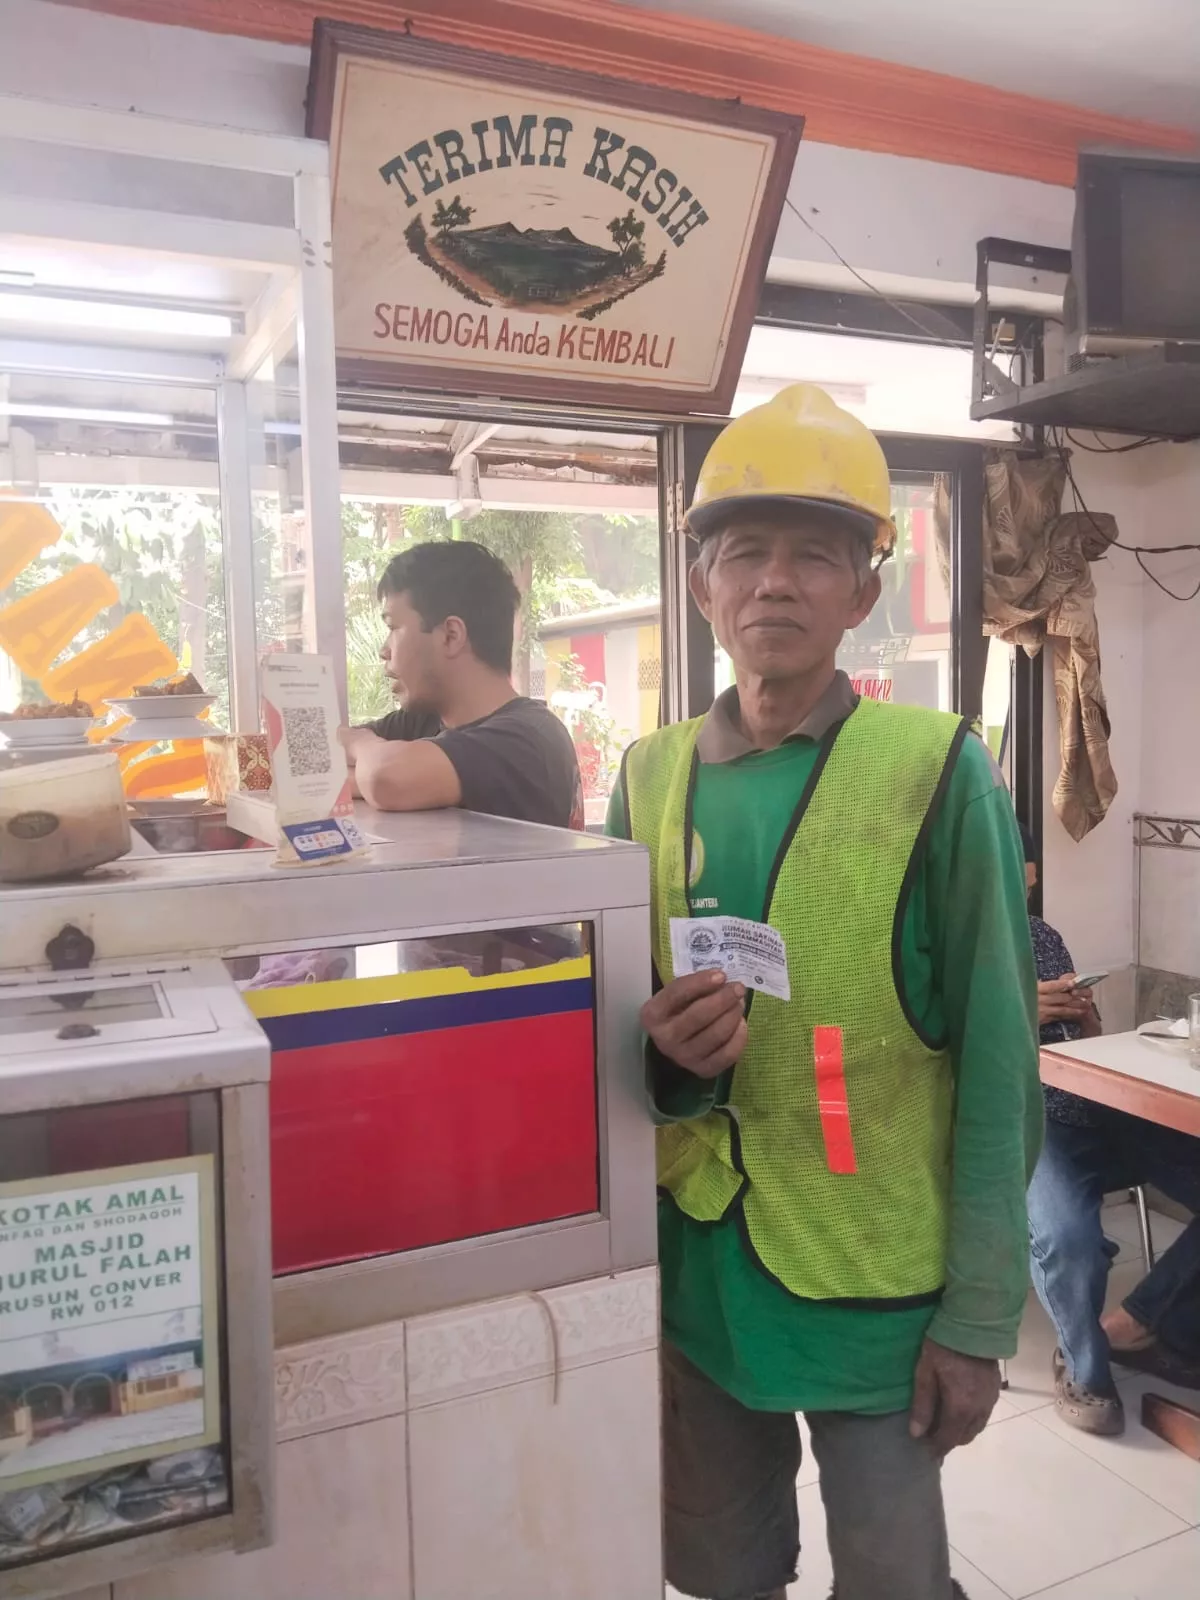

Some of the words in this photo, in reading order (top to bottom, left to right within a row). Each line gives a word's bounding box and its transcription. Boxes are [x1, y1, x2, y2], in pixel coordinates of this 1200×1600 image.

[379, 115, 573, 208] TERIMA
[583, 127, 710, 248] KASIH
[373, 303, 489, 350] SEMOGA
[494, 317, 550, 357] Anda
[556, 323, 675, 369] KEMBALI
[106, 1185, 184, 1210] AMAL
[52, 1222, 85, 1235] DAN
[35, 1233, 144, 1264] MASJID
[0, 1263, 87, 1292] URUL
[100, 1245, 191, 1274] FALAH
[0, 1289, 79, 1315] RUSUN
[90, 1271, 181, 1298] CONVER
[51, 1303, 84, 1320] RW
[95, 1295, 134, 1313] 012
